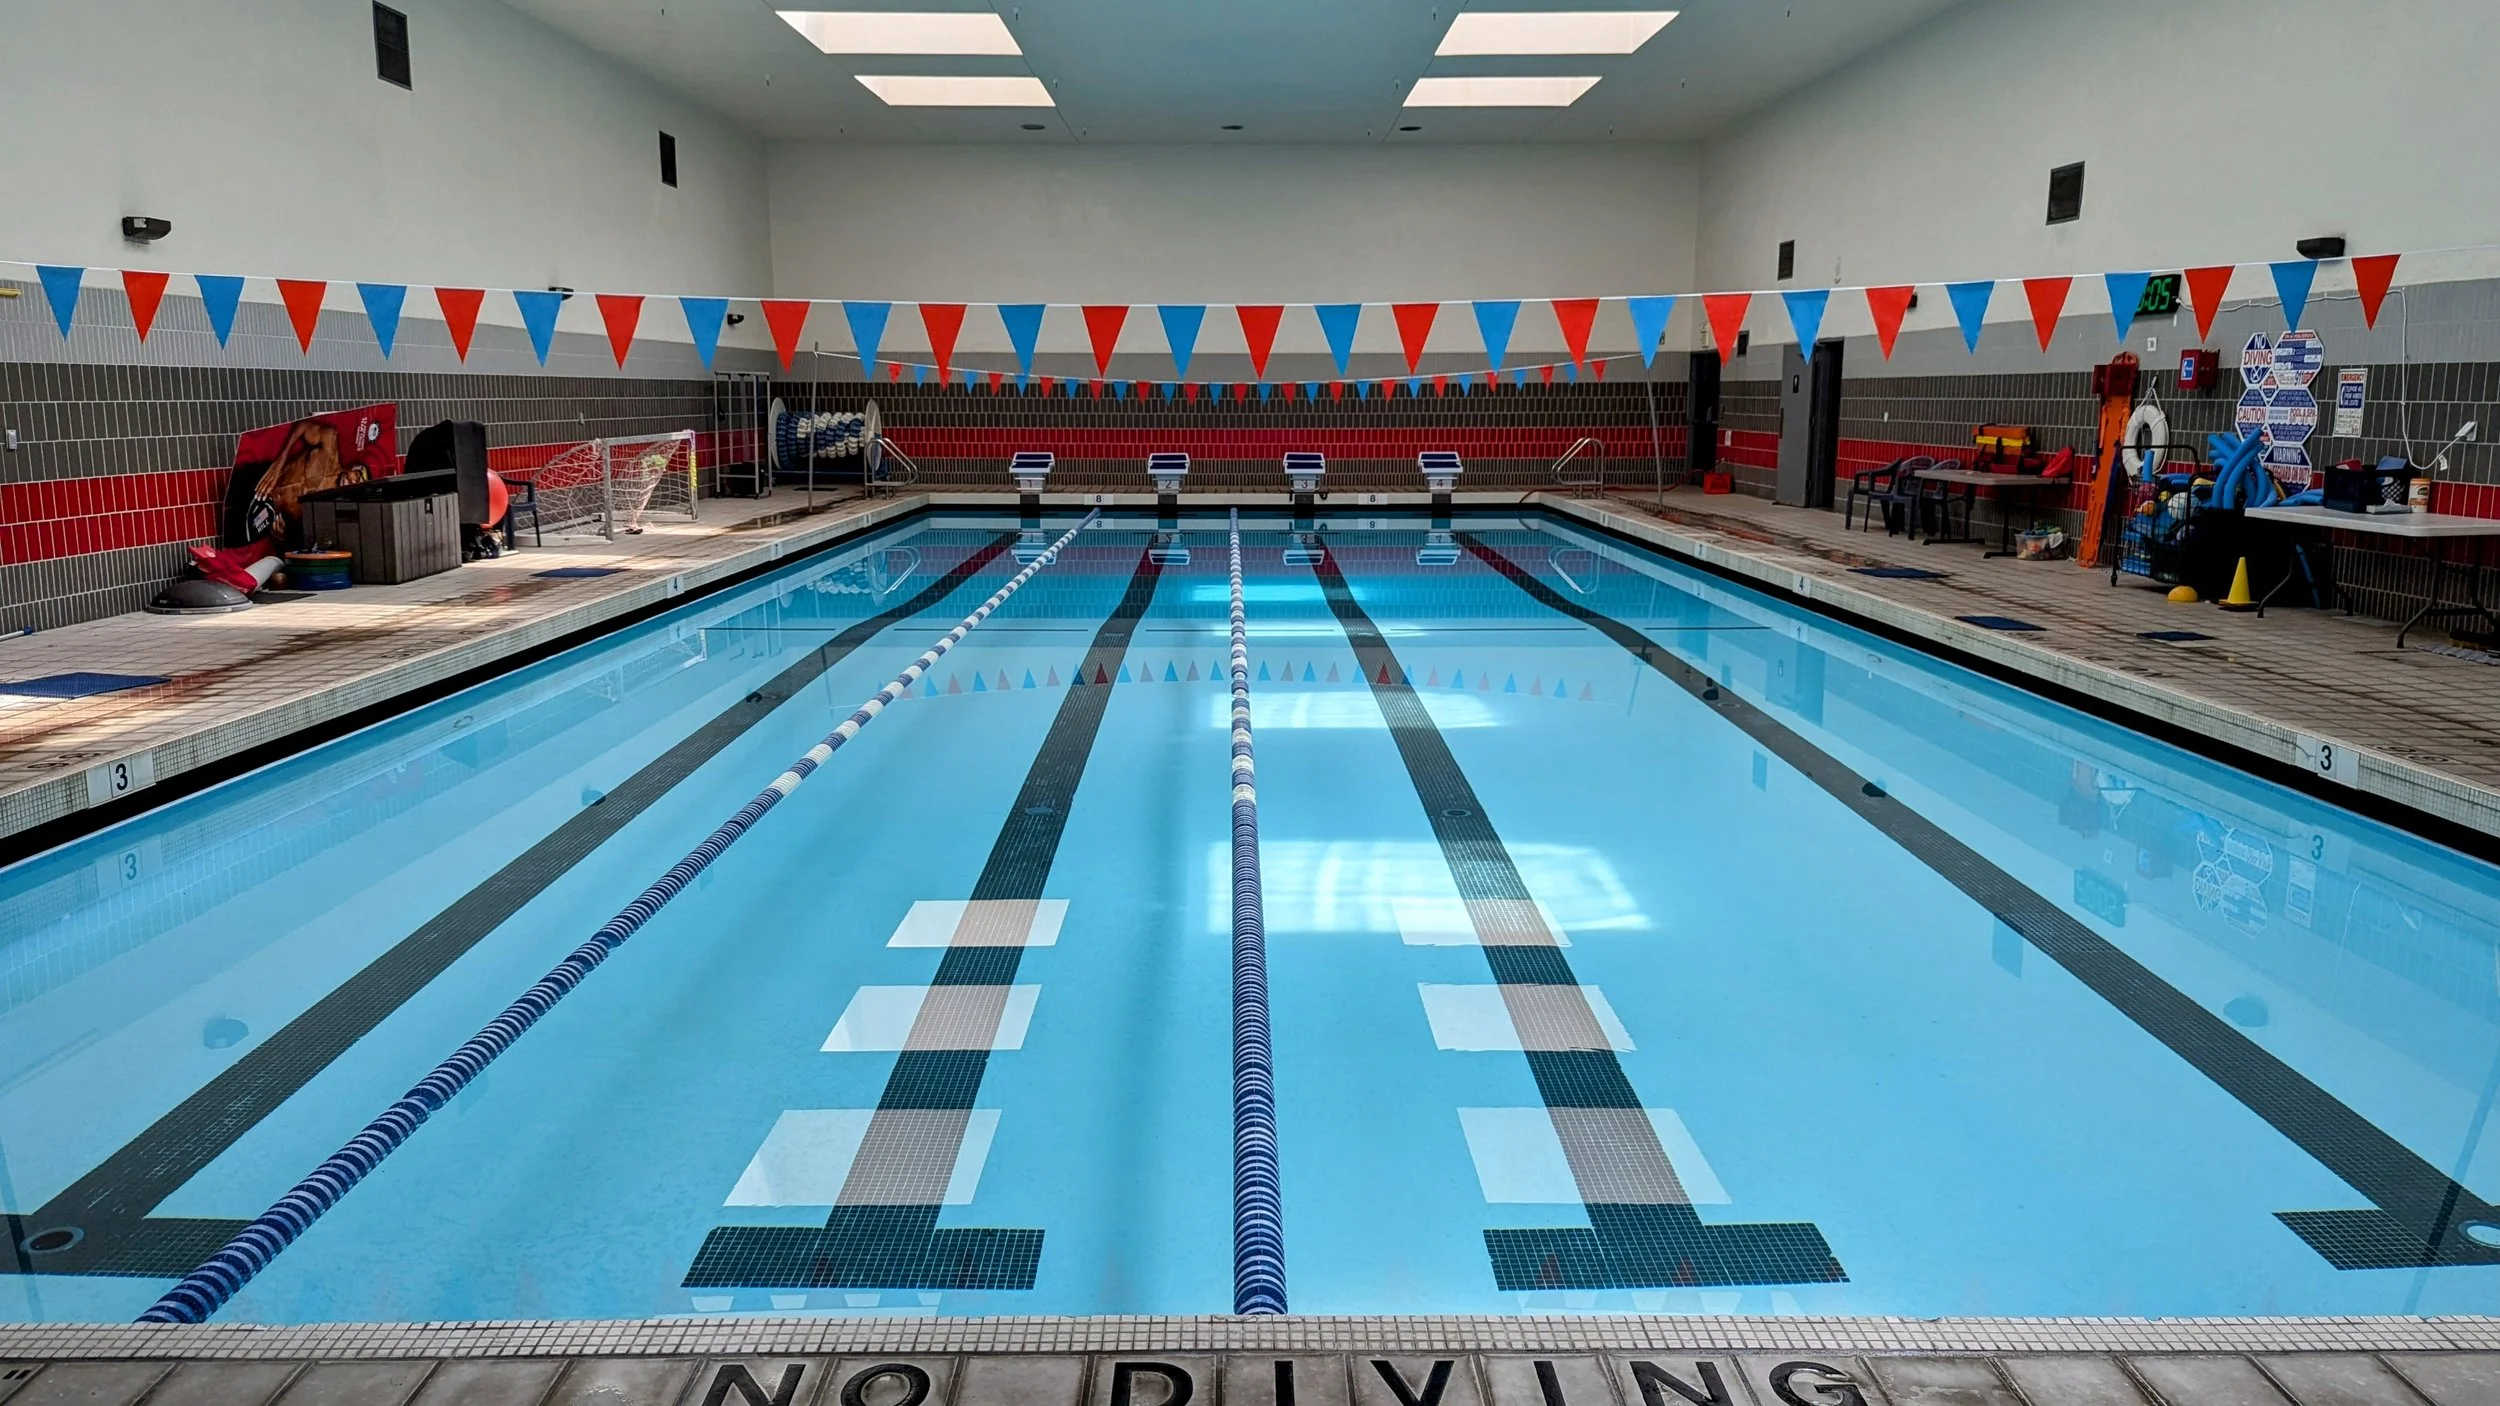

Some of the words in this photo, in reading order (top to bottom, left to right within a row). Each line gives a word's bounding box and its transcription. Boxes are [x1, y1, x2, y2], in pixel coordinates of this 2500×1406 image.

[2254, 334, 2267, 349] NO
[2243, 350, 2272, 365] DIVING
[2238, 408, 2266, 421] CAUTION
[2273, 447, 2301, 464] WARNING
[1302, 480, 1308, 488] 3
[1437, 479, 1443, 487] 4
[2320, 745, 2332, 770] 3
[115, 763, 128, 790] 3
[701, 1362, 931, 1406] NO
[1107, 1359, 1865, 1406] DIVING
